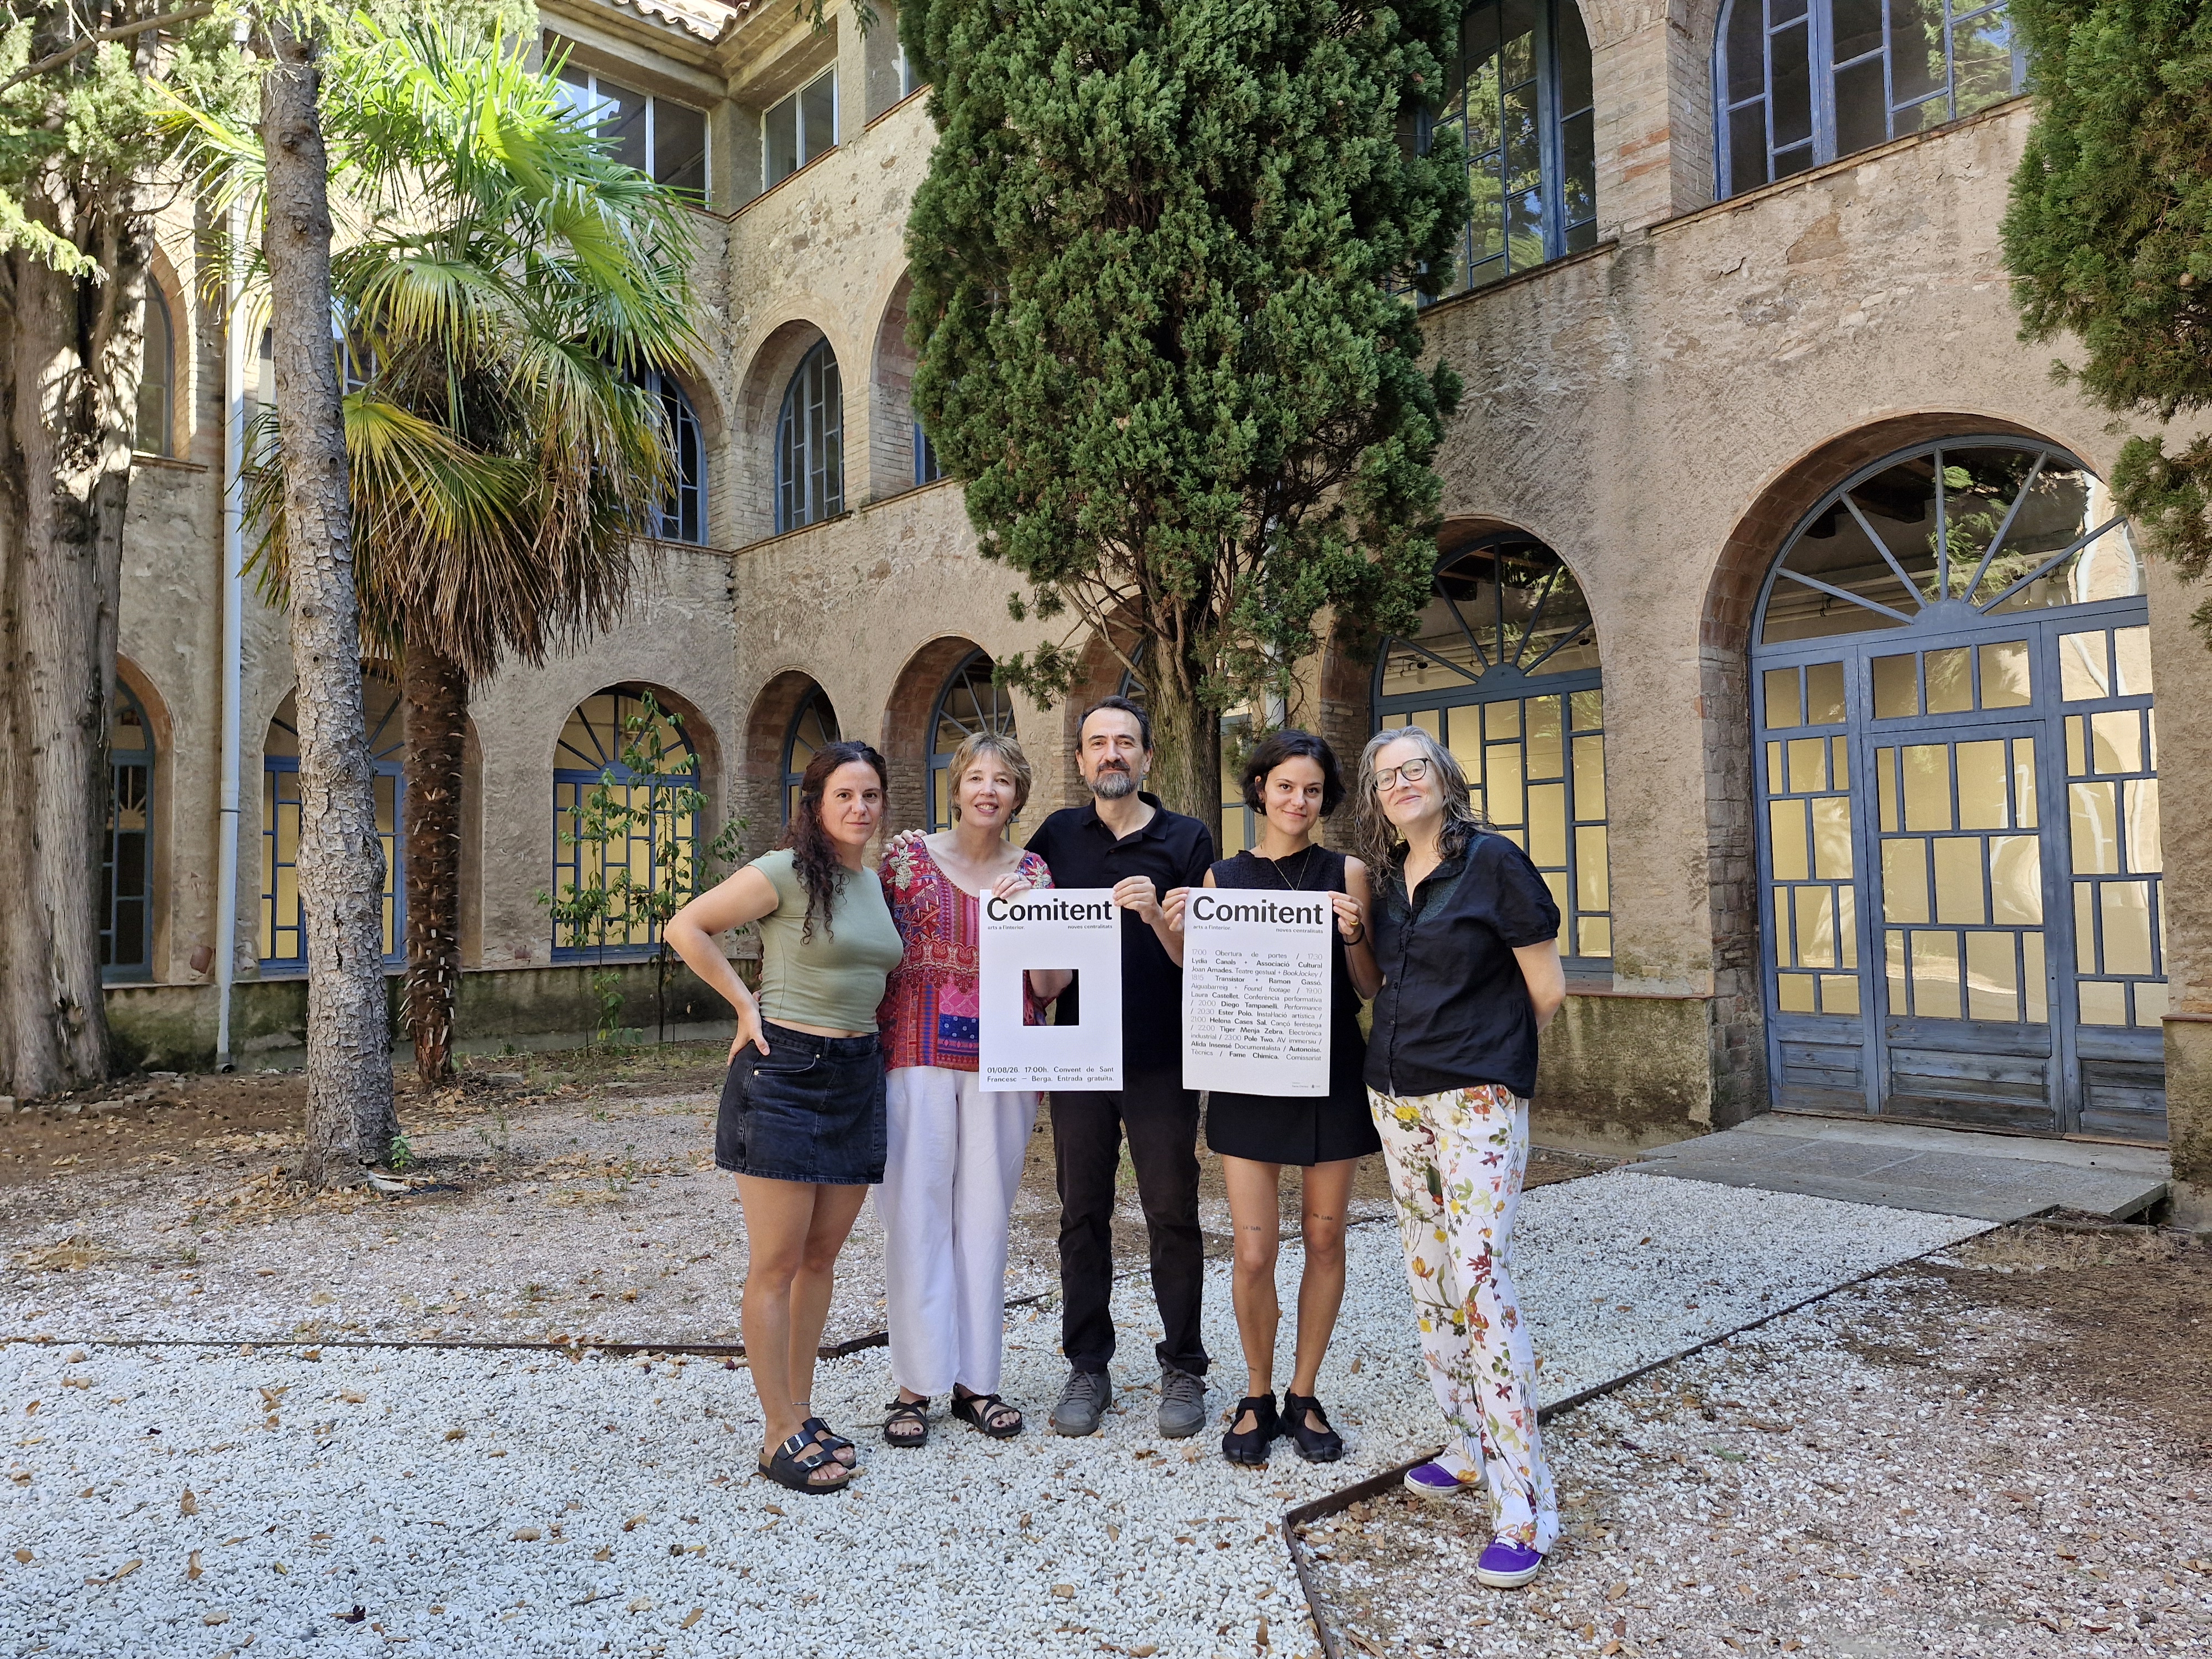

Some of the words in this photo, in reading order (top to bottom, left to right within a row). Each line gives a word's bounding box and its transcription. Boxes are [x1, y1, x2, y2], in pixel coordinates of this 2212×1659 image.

[987, 897, 1112, 921] Comitent
[1193, 895, 1323, 925] Comitent
[1191, 983, 1228, 991] Aiguabarreig
[1087, 1074, 1114, 1083] gratuïta.
